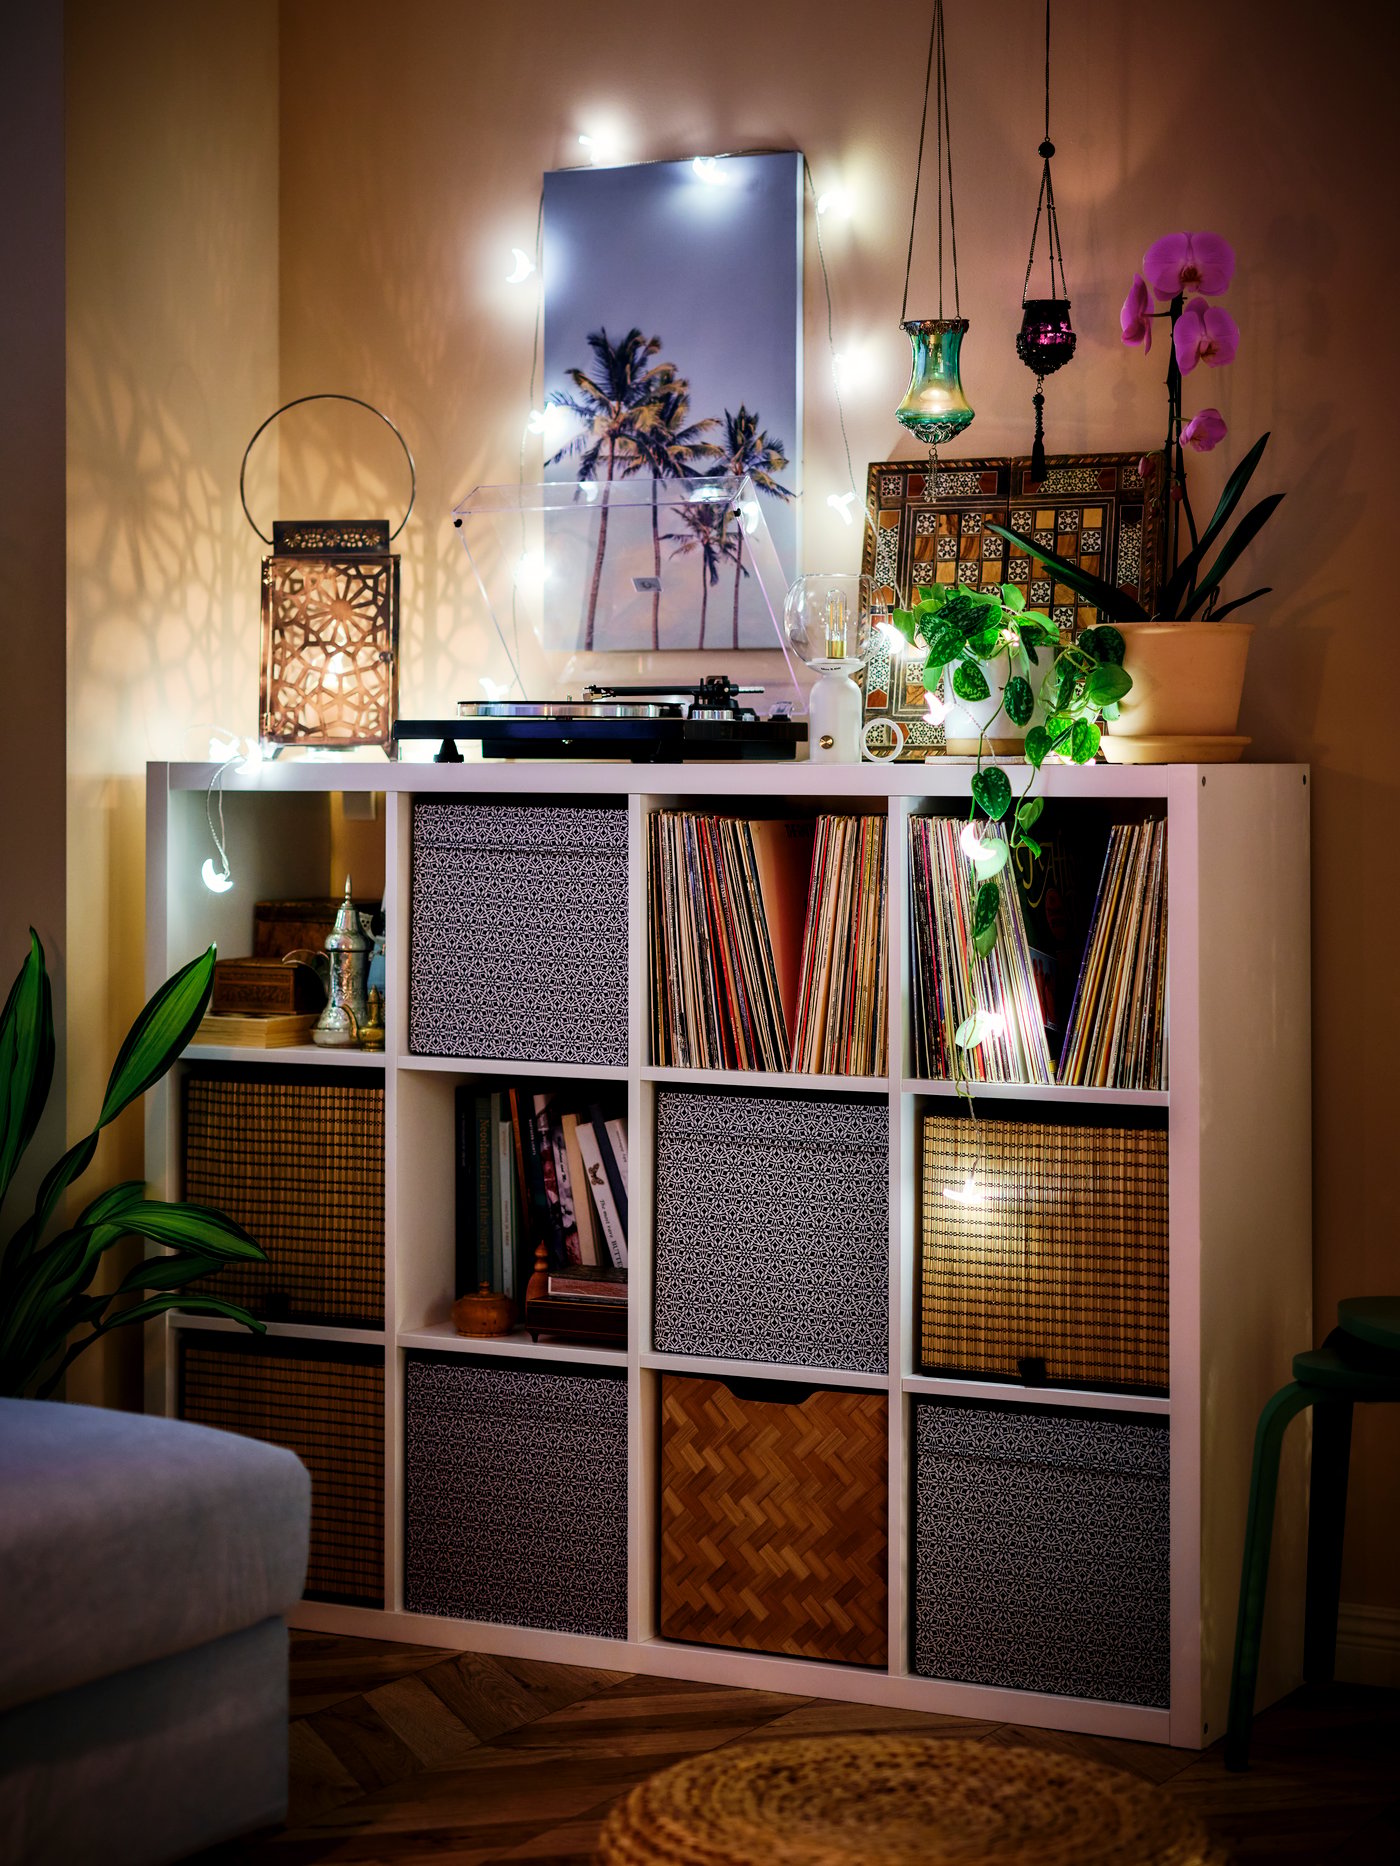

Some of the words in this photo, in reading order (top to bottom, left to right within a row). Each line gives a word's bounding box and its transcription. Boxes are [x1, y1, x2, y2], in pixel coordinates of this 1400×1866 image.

[480, 1118, 490, 1193] Neoclassicism
[602, 1211, 610, 1224] most
[606, 1225, 614, 1239] rare
[611, 1240, 623, 1270] BUTTE
